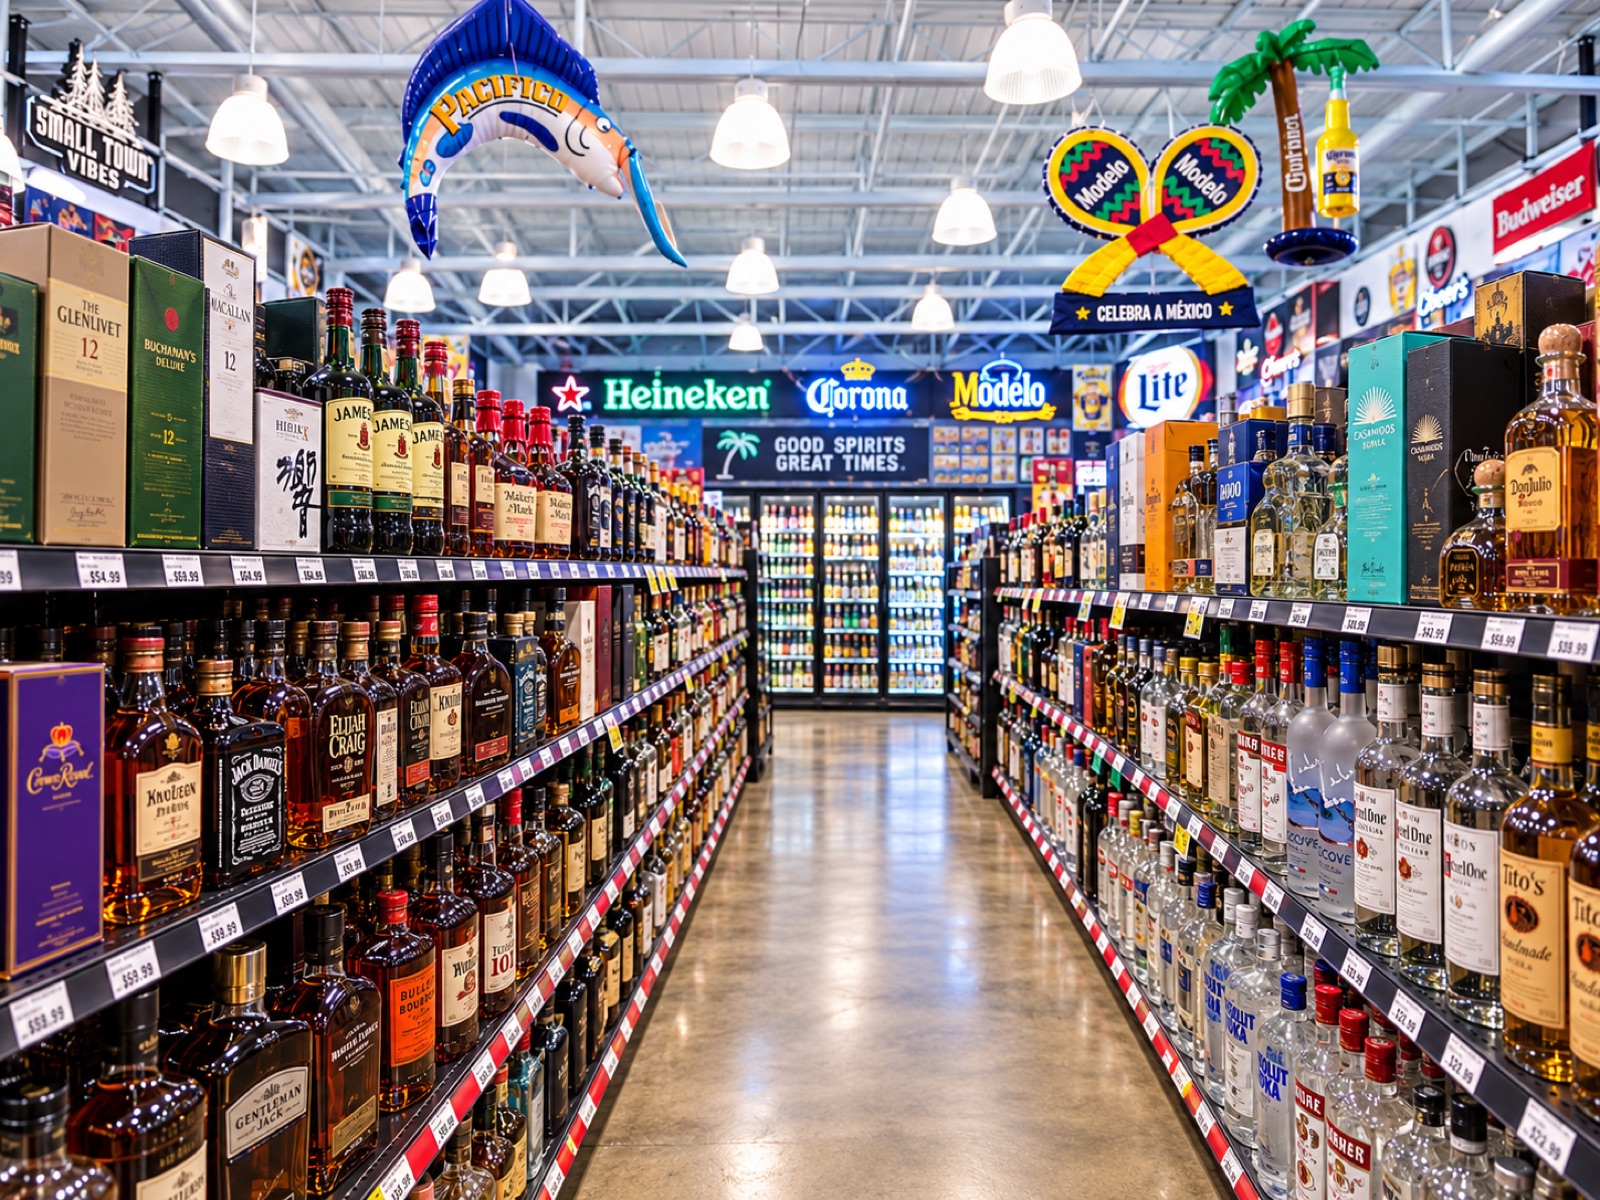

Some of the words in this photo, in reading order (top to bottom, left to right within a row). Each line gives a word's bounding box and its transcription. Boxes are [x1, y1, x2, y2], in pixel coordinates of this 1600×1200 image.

[430, 73, 571, 137] PACIFICO
[35, 105, 98, 159] SMALL
[103, 138, 149, 182] TOWN
[67, 148, 121, 191] VIBES
[1173, 153, 1228, 206] Modelo
[1074, 159, 1129, 211] Modelo
[1496, 174, 1585, 239] Budweiser
[57, 304, 122, 338] GLENLIVET
[82, 299, 100, 315] THE
[1097, 304, 1150, 322] CELEBRA
[1154, 303, 1164, 320] A
[1166, 299, 1213, 320] MÉXICO
[81, 337, 99, 360] 12
[144, 338, 197, 363] BUCHANAN'S
[224, 350, 236, 372] 12
[603, 373, 770, 411] Heineken
[806, 377, 909, 418] Corona
[949, 371, 1046, 408] Modelo
[1137, 370, 1188, 412] Lite
[162, 429, 175, 445] 12
[373, 416, 413, 433] JAMES
[774, 436, 824, 454] GOOD
[834, 436, 906, 454] SPIRITS
[775, 454, 833, 472] GREAT
[329, 713, 367, 737] ELIJAH
[329, 731, 367, 759] CRAIG
[231, 757, 253, 786] JACK
[1503, 863, 1546, 896] Tito's
[490, 950, 514, 977] 101
[235, 1083, 302, 1130] GENTLEMAN
[256, 1106, 283, 1131] JACK
